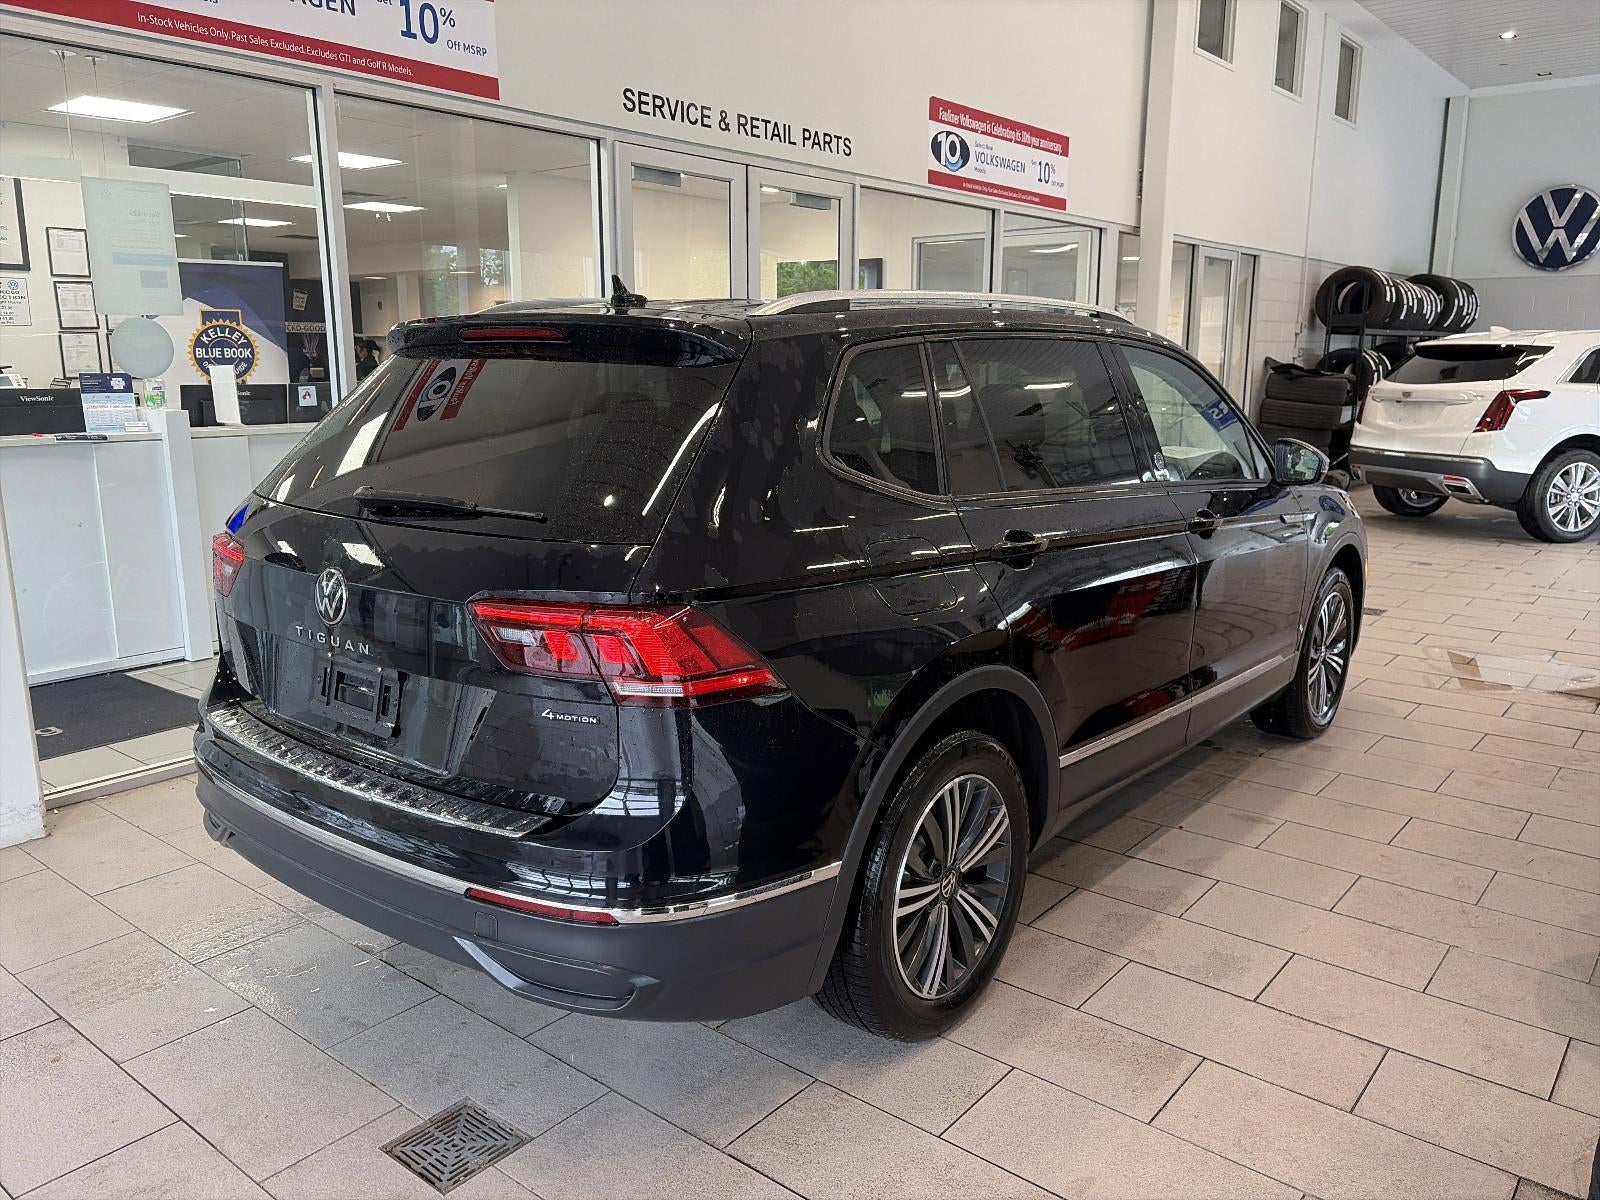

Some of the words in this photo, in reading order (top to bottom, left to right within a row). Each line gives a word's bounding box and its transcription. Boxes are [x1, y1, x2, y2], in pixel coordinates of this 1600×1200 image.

[137, 12, 174, 28] In-Stock
[174, 20, 208, 35] Vehicles
[231, 31, 248, 43] Past
[249, 35, 269, 48] Sales
[306, 46, 338, 61] Excludes
[338, 52, 351, 63] GTI
[352, 56, 366, 66] and
[366, 58, 382, 70] Golf
[382, 62, 387, 70] R
[446, 39, 461, 51] Off
[462, 43, 488, 58] MSRP
[622, 87, 712, 129] SERVICE
[718, 109, 731, 133] &
[736, 113, 797, 146] RETAIL
[801, 127, 852, 157] PARTS
[938, 106, 960, 125] Faulkner
[960, 112, 987, 134] Volkswagen
[991, 120, 1016, 143] Celebrating
[937, 132, 961, 166] 10
[974, 151, 1026, 174] VOLKSWAGEN
[200, 327, 247, 345] KELLEY
[195, 347, 222, 359] BLUE
[224, 347, 252, 359] BOOK
[296, 625, 369, 655] TIGUAN
[541, 708, 597, 724] 4MOTION
